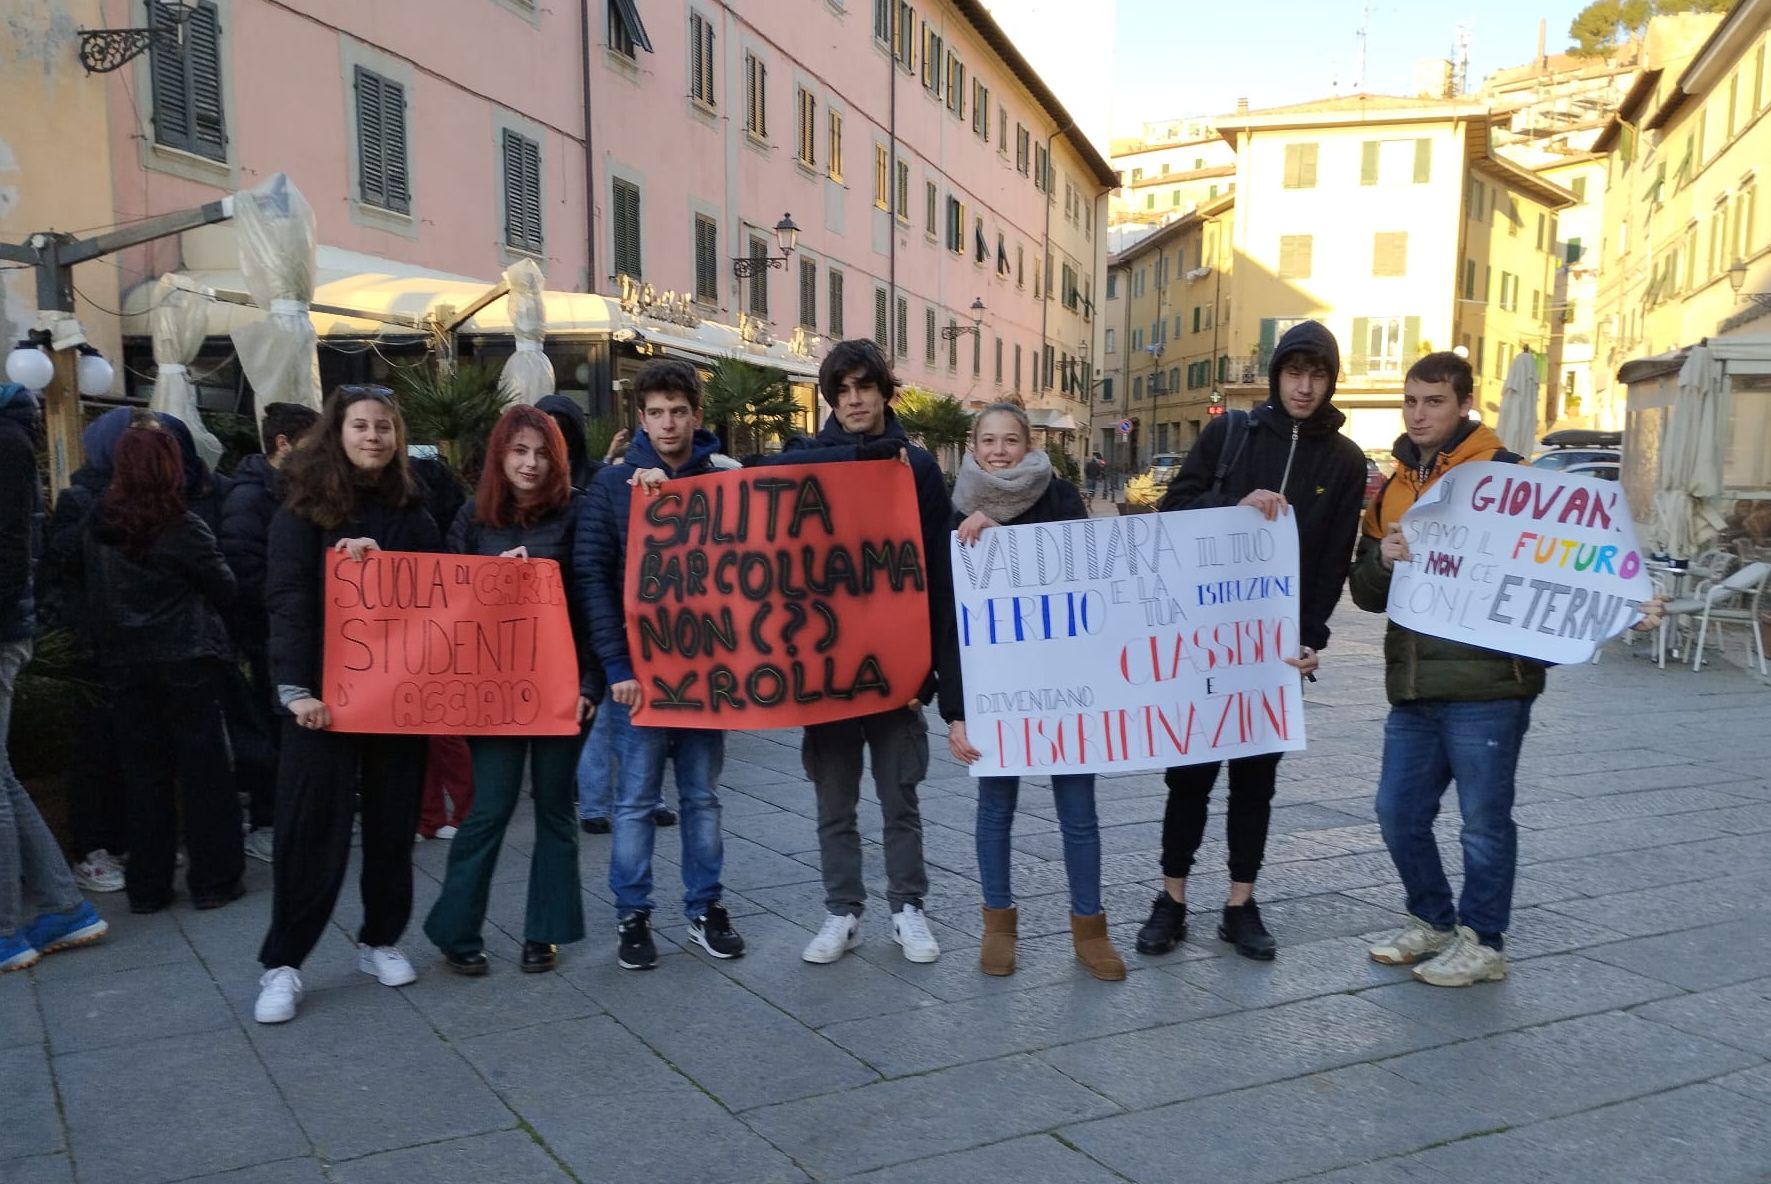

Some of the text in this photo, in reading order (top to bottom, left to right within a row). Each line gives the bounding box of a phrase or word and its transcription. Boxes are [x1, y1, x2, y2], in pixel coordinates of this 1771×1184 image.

[645, 474, 834, 548] SALITA
[637, 538, 925, 601] BARCOLLAMA
[955, 514, 1275, 589] VALDITARA IL TUO
[1407, 519, 1469, 550] SIAMO
[1512, 532, 1641, 580] FUTURO
[1424, 550, 1463, 578] NON
[334, 557, 448, 609] SCUOLA
[456, 565, 470, 585] DI
[961, 574, 1295, 647] MERITO E LA ISTRUZIONE
[1137, 598, 1188, 627] TUA
[341, 617, 538, 675] STUDENTI
[638, 601, 838, 661] NON (?)
[1120, 616, 1299, 686] CLASSISMO
[392, 680, 541, 727] ACCIAIO
[652, 654, 890, 712] KROLLA
[976, 685, 1095, 714] DIVENTANO
[1206, 677, 1217, 694] E
[996, 684, 1293, 768] DISCRIMINAZIONE
